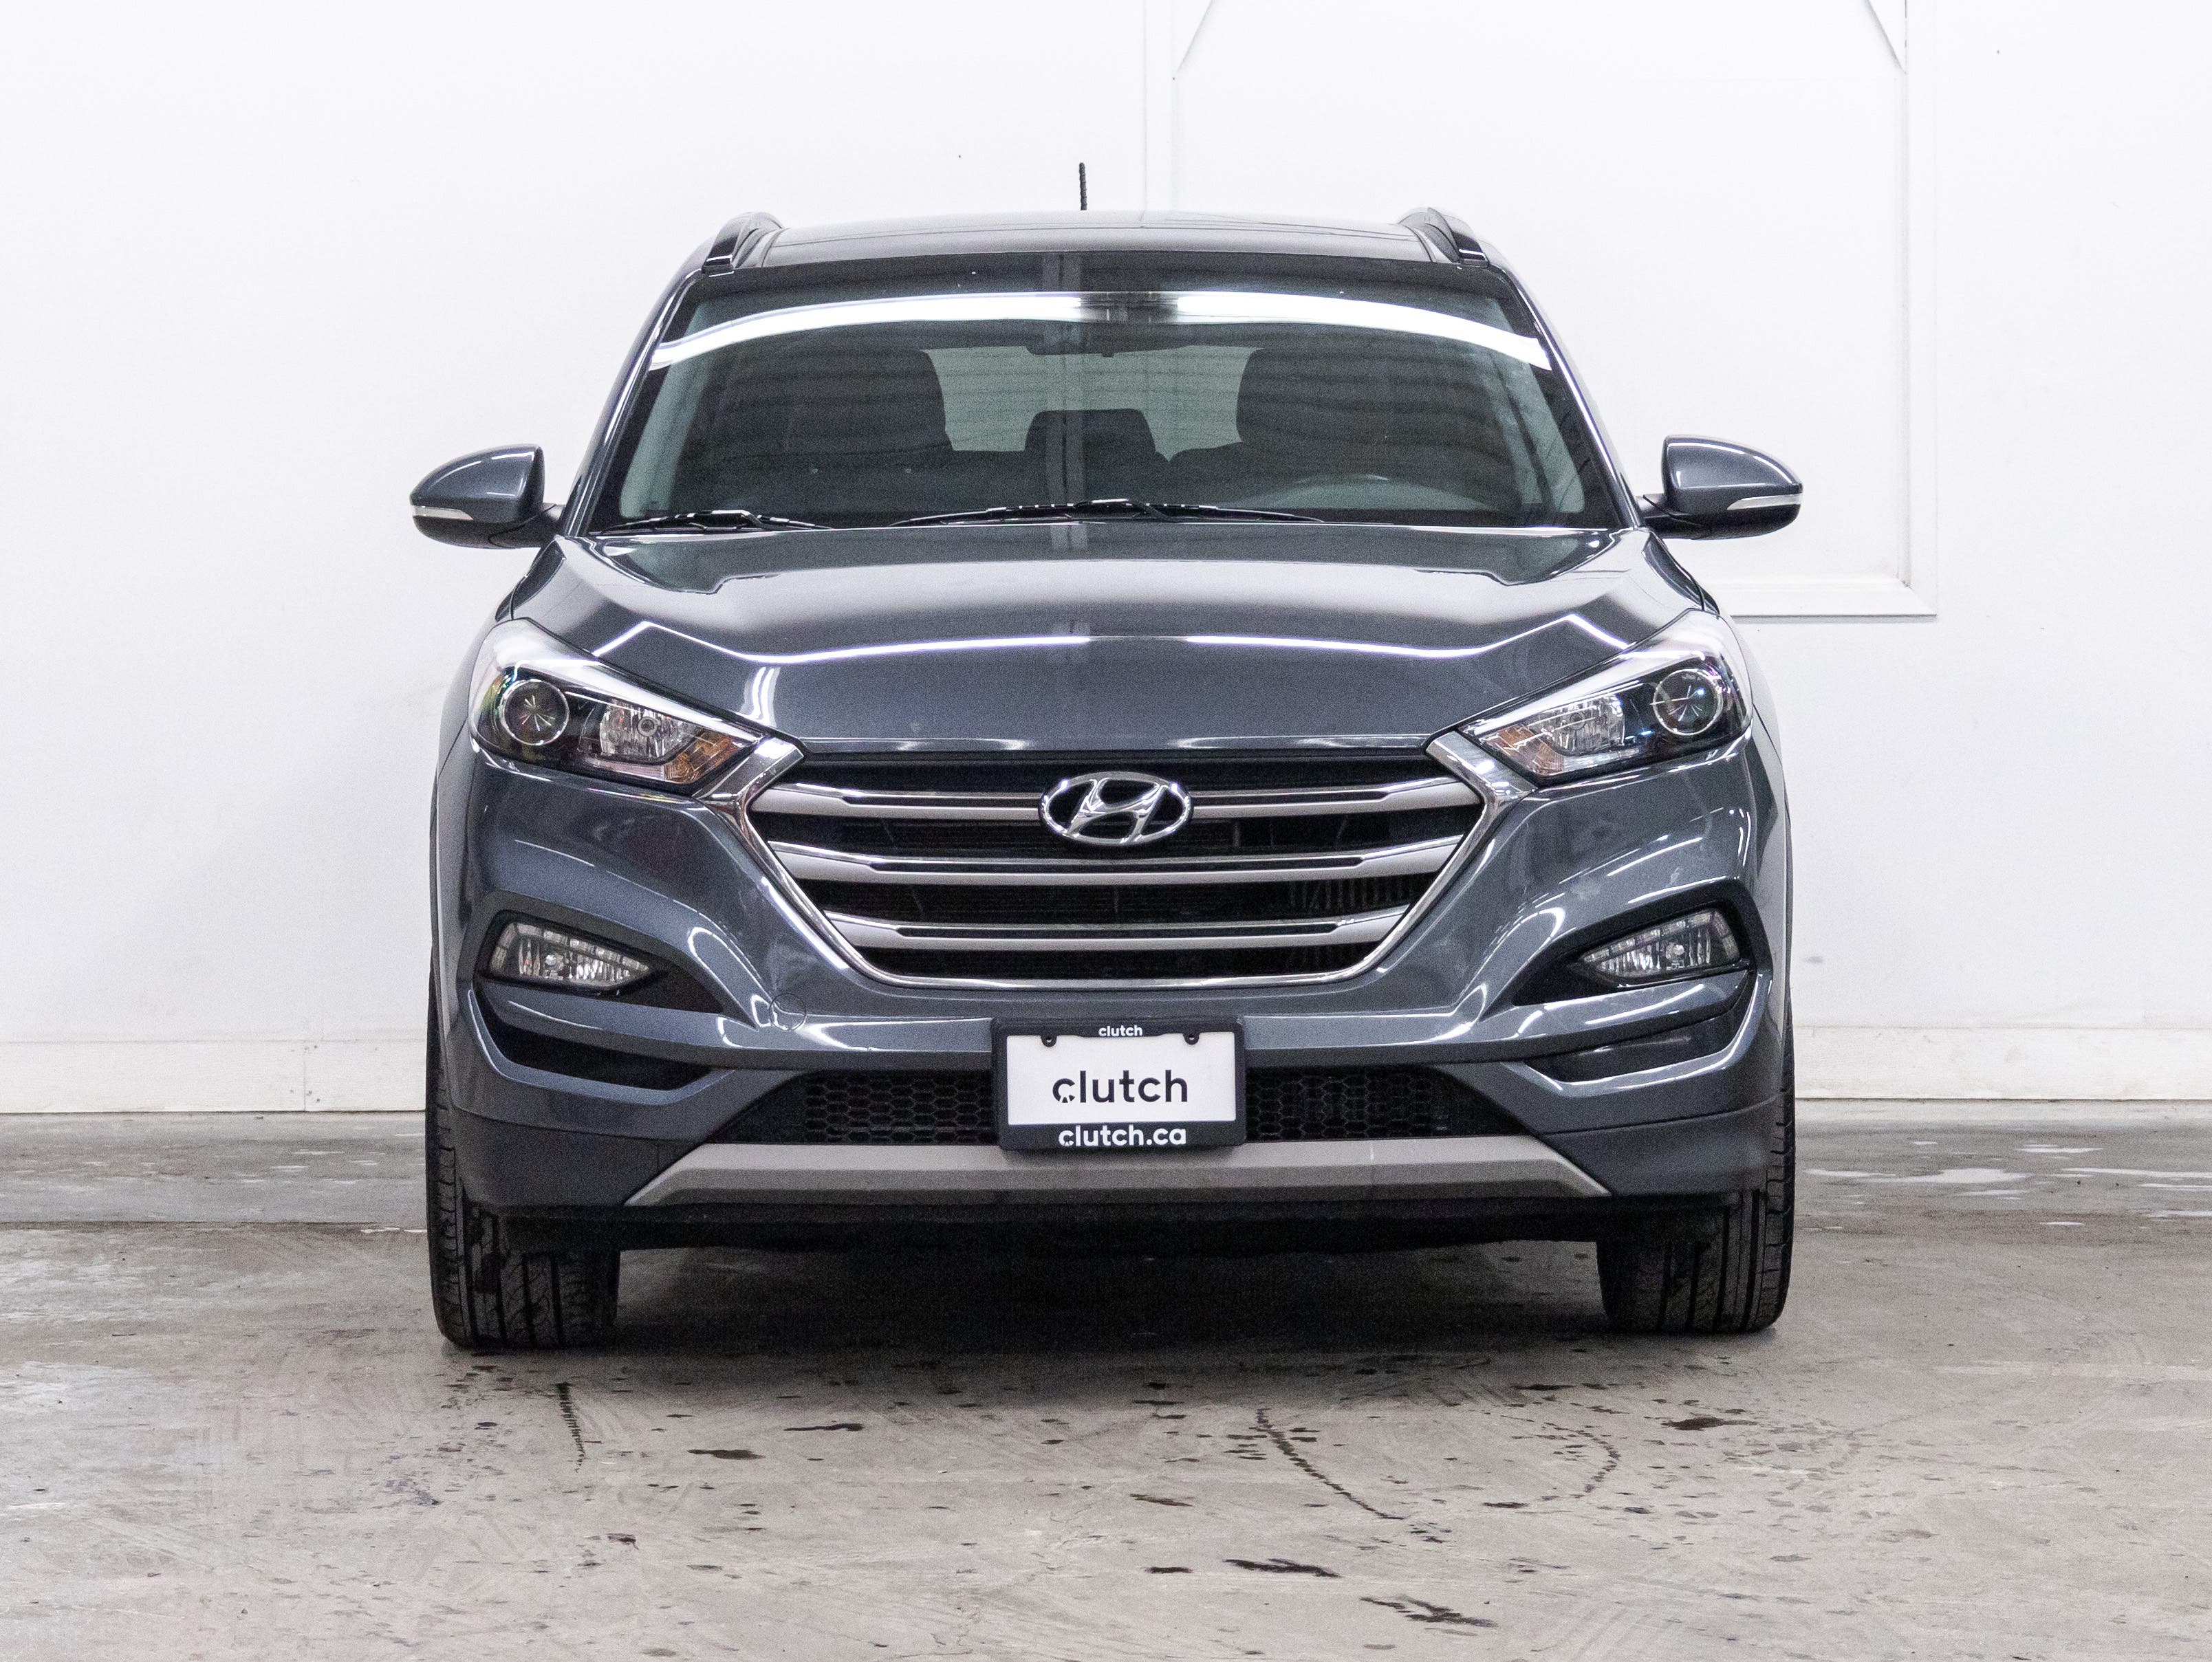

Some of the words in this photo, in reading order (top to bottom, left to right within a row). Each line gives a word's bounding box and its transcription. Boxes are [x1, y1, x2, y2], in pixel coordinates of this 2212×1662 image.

[1098, 1025, 1143, 1038] clutch
[1052, 1069, 1188, 1104] clutch
[1058, 1124, 1186, 1147] clutch.ca
